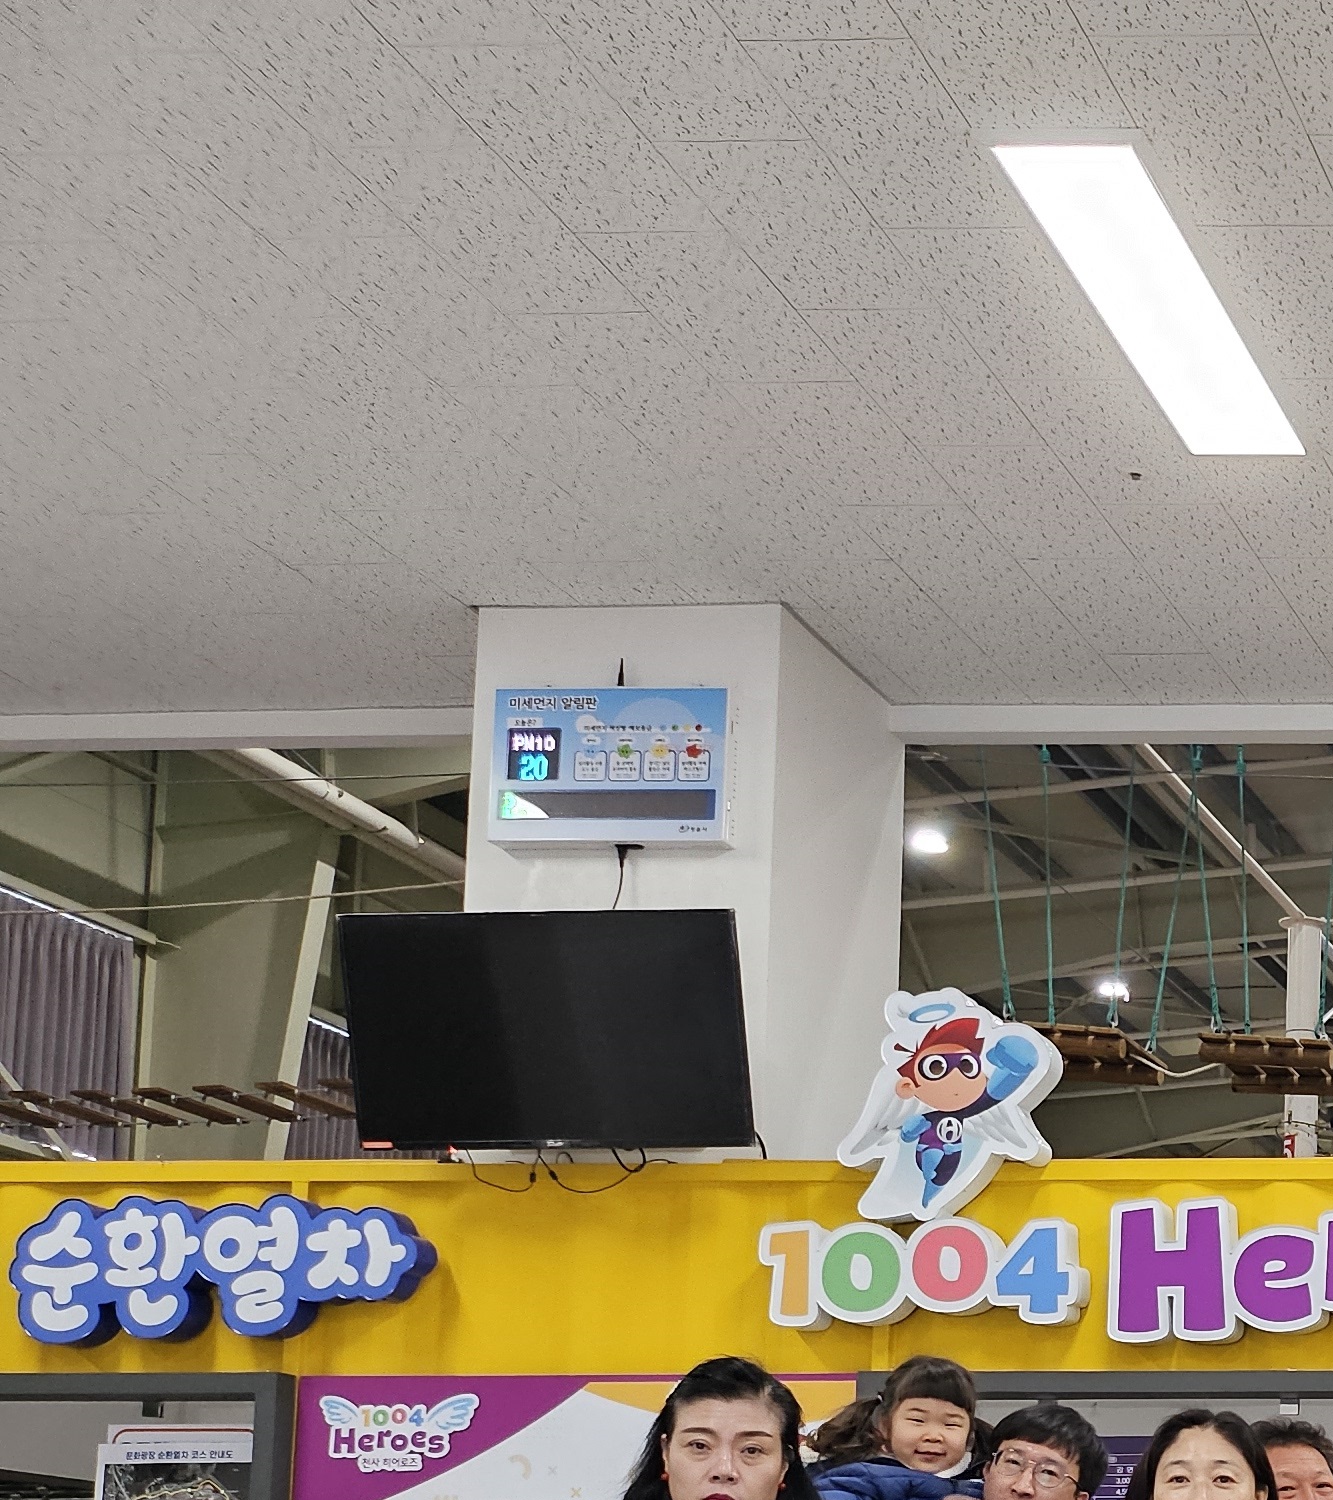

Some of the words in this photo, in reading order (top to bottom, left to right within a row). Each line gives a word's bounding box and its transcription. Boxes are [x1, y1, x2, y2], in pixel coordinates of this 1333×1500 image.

[509, 696, 557, 710] 미세먼지
[561, 696, 598, 711] 알림판
[519, 754, 549, 781] 20
[22, 1206, 405, 1332] 순환열차
[769, 1225, 1069, 1317] 1004
[361, 1408, 425, 1427] 1004
[332, 1428, 446, 1455] Heroes
[126, 1451, 155, 1461] 문화광장
[158, 1451, 189, 1460] 순환열차
[191, 1451, 207, 1460] 코스
[209, 1450, 234, 1459] 안내도
[361, 1457, 380, 1469] 천사
[383, 1457, 418, 1468] 히어로즈
[1115, 1477, 1131, 1485] 3,00
